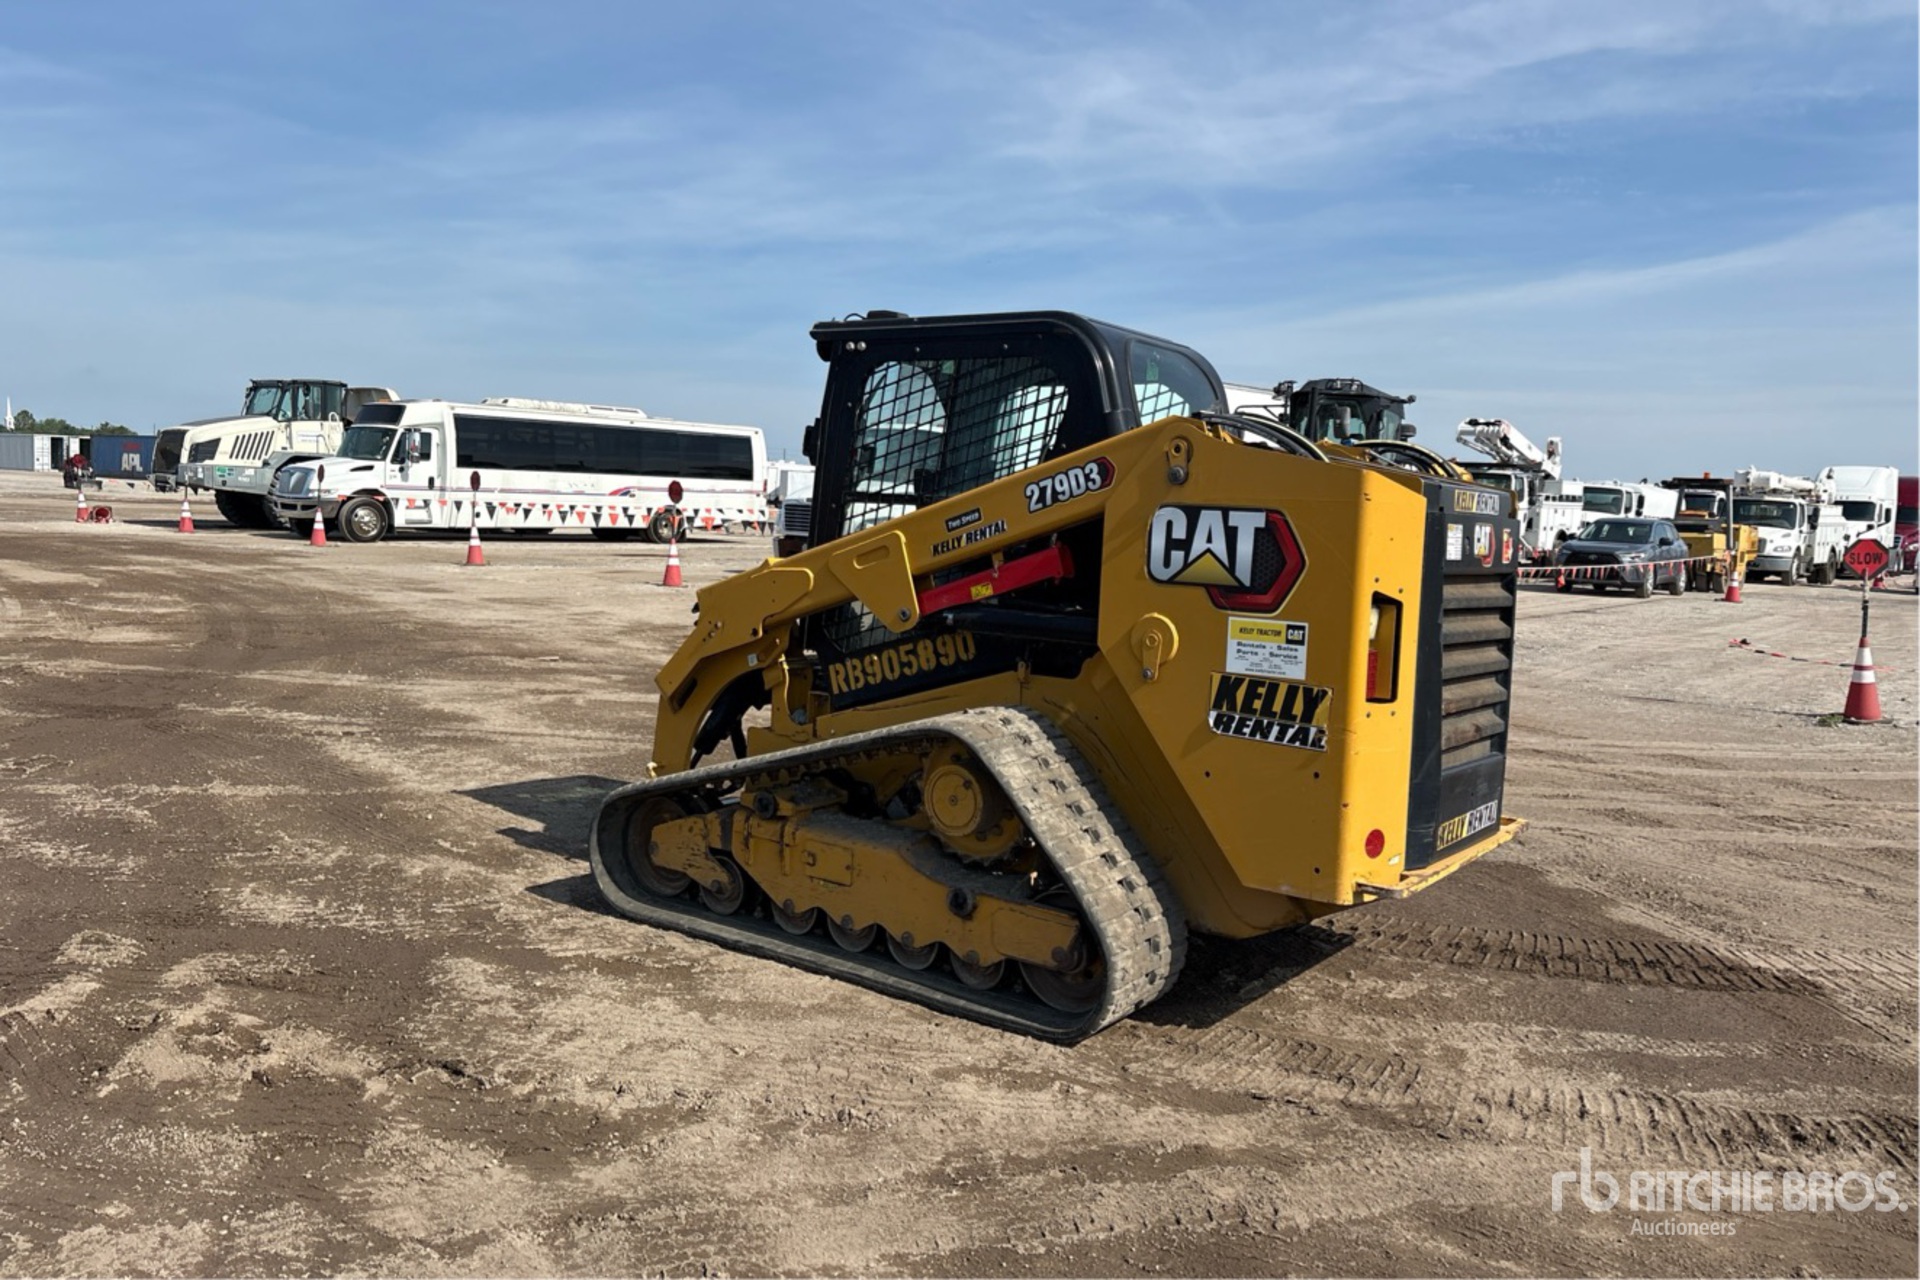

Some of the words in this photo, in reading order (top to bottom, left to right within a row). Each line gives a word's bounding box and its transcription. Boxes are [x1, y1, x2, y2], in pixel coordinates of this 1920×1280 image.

[121, 452, 143, 471] APL
[1025, 462, 1102, 513] 279D3
[1454, 490, 1476, 511] KELLY
[932, 534, 964, 557] KELLY
[964, 520, 1007, 545] RENTAL
[1150, 506, 1266, 588] CAT
[1849, 552, 1883, 565] SLOW
[1236, 641, 1267, 650] Rentals
[1287, 629, 1304, 640] CAT
[828, 629, 976, 695] RB905890
[1236, 648, 1259, 656] Parts
[1268, 651, 1298, 660] Service
[1212, 674, 1328, 724] KELLY
[1212, 712, 1327, 750] RENTAL
[1438, 815, 1466, 848] KELLY
[1466, 802, 1497, 834] RENTAL
